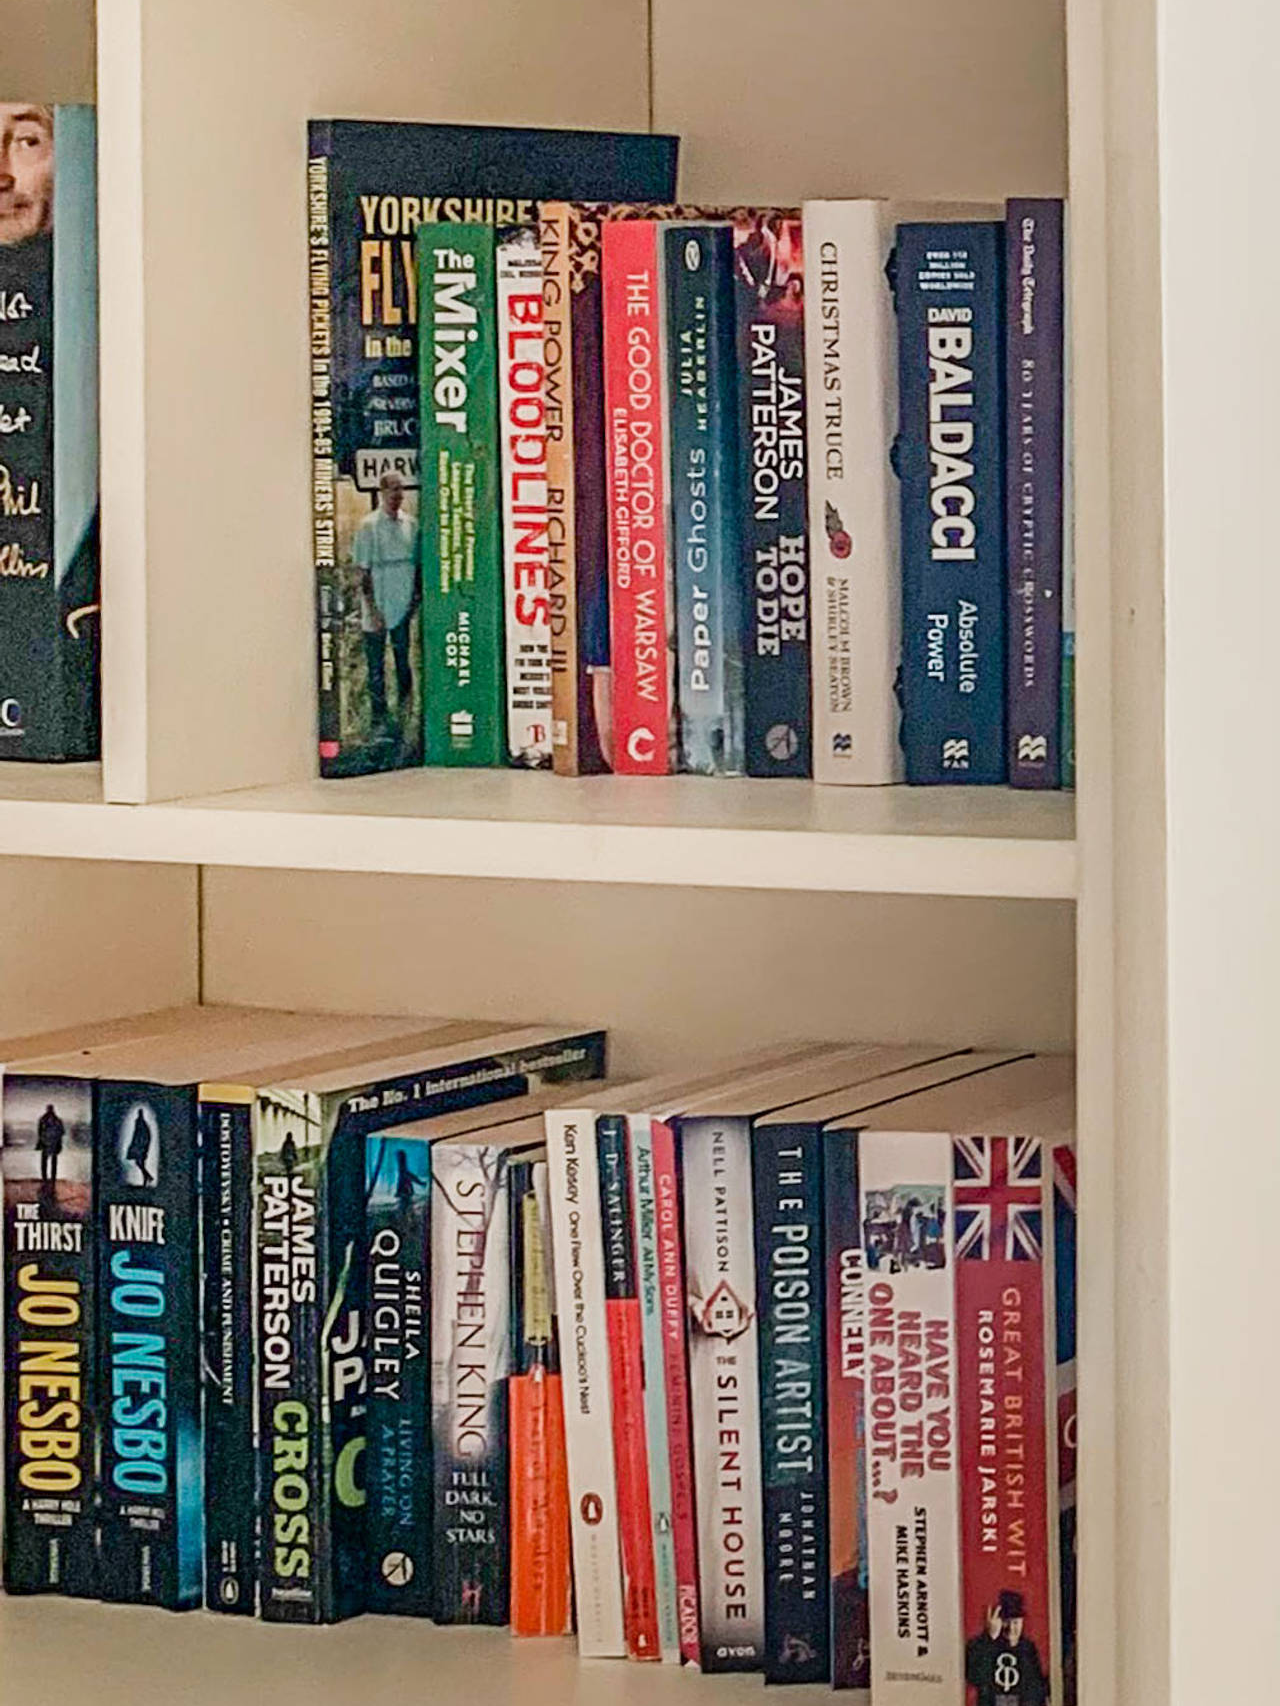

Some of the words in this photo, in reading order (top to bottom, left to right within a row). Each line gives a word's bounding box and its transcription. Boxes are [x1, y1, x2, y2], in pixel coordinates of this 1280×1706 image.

[433, 248, 475, 269] The
[626, 270, 649, 318] THE
[819, 241, 841, 390] CHRISTMAS
[927, 307, 973, 323] DAVID
[433, 272, 477, 434] Mixer
[627, 327, 653, 406] GOOD
[681, 330, 692, 396] JULIA
[611, 407, 627, 499] ELISABETH
[750, 323, 780, 521] PATTERSON
[777, 369, 803, 482] JAMES
[824, 396, 844, 481] TRUCE
[927, 326, 977, 562] BALDACCI
[507, 293, 550, 629] BLOODLINES
[629, 413, 655, 530] DOCTOR
[687, 448, 707, 571] Ghosts
[613, 502, 629, 588] GIFFORD
[632, 539, 656, 577] OF
[779, 535, 807, 641] HOPE
[446, 632, 458, 667] COX
[457, 612, 470, 687] MICHAEL
[633, 587, 659, 703] WARSAW
[690, 579, 711, 691] Paper
[926, 612, 948, 681] Power
[957, 599, 976, 694] Absolute
[347, 1094, 378, 1114] The
[383, 1089, 409, 1107] No.
[413, 1083, 420, 1102] 1
[424, 1063, 517, 1100] international
[519, 1046, 587, 1076] bestseller
[219, 1113, 231, 1216] DOSTOYEVSKY
[565, 1124, 578, 1154] Ken
[711, 1132, 725, 1177] NELL
[16, 1203, 41, 1221] THE
[565, 1157, 579, 1205] Kesey
[658, 1174, 672, 1231] CAROL
[777, 1147, 804, 1210] THE
[14, 1221, 84, 1253] THIRST
[109, 1202, 166, 1246] KNIFE
[221, 1229, 234, 1275] CRIME
[291, 1176, 316, 1303] JAMES
[569, 1211, 580, 1239] One
[571, 1241, 581, 1268] Flew
[714, 1186, 730, 1272] PATTISON
[110, 1250, 166, 1318] JO
[221, 1278, 234, 1309] AND
[262, 1176, 290, 1389] PATTERSON
[456, 1181, 487, 1350] STEPHEN
[573, 1270, 584, 1300] Over
[662, 1242, 675, 1278] ANN
[772, 1223, 810, 1345] POISON
[17, 1264, 80, 1327] JO
[370, 1229, 400, 1400] QUIGLEY
[405, 1271, 422, 1359] SHEILA
[574, 1303, 585, 1324] the
[665, 1282, 679, 1341] DUFFY
[221, 1313, 235, 1406] PUNISHMENT
[575, 1325, 588, 1384] Cuckoo's
[716, 1355, 737, 1367] THE
[898, 1310, 923, 1407] HEARD
[925, 1319, 949, 1395] HAVE
[1002, 1287, 1021, 1384] GREAT
[18, 1339, 81, 1493] NESBO
[111, 1331, 168, 1495] NESBO
[458, 1365, 488, 1460] KING
[580, 1386, 591, 1415] Nest
[776, 1357, 813, 1475] ARTIST
[978, 1310, 995, 1458] ROSEMARIE
[400, 1421, 413, 1488] LIVING
[717, 1376, 741, 1491] SILENT
[900, 1414, 925, 1479] THE
[926, 1401, 952, 1471] YOU
[1004, 1392, 1024, 1520] BRITISH
[272, 1400, 309, 1577] CROSS
[400, 1497, 414, 1525] ON
[452, 1474, 488, 1488] FULL
[980, 1467, 997, 1554] JARSKI
[446, 1526, 495, 1544] STARS
[458, 1509, 485, 1524] NO
[778, 1512, 793, 1584] MOORE
[800, 1492, 816, 1600] JONATHAN
[895, 1525, 907, 1566] MIKE
[914, 1506, 927, 1573] STEPHEN
[723, 1510, 746, 1620] HOUSE
[1007, 1528, 1026, 1577] WIT
[897, 1569, 910, 1639] HASKINS
[915, 1577, 929, 1643] ARNOTT
[717, 1646, 756, 1659] avon
[917, 1645, 928, 1658] &
